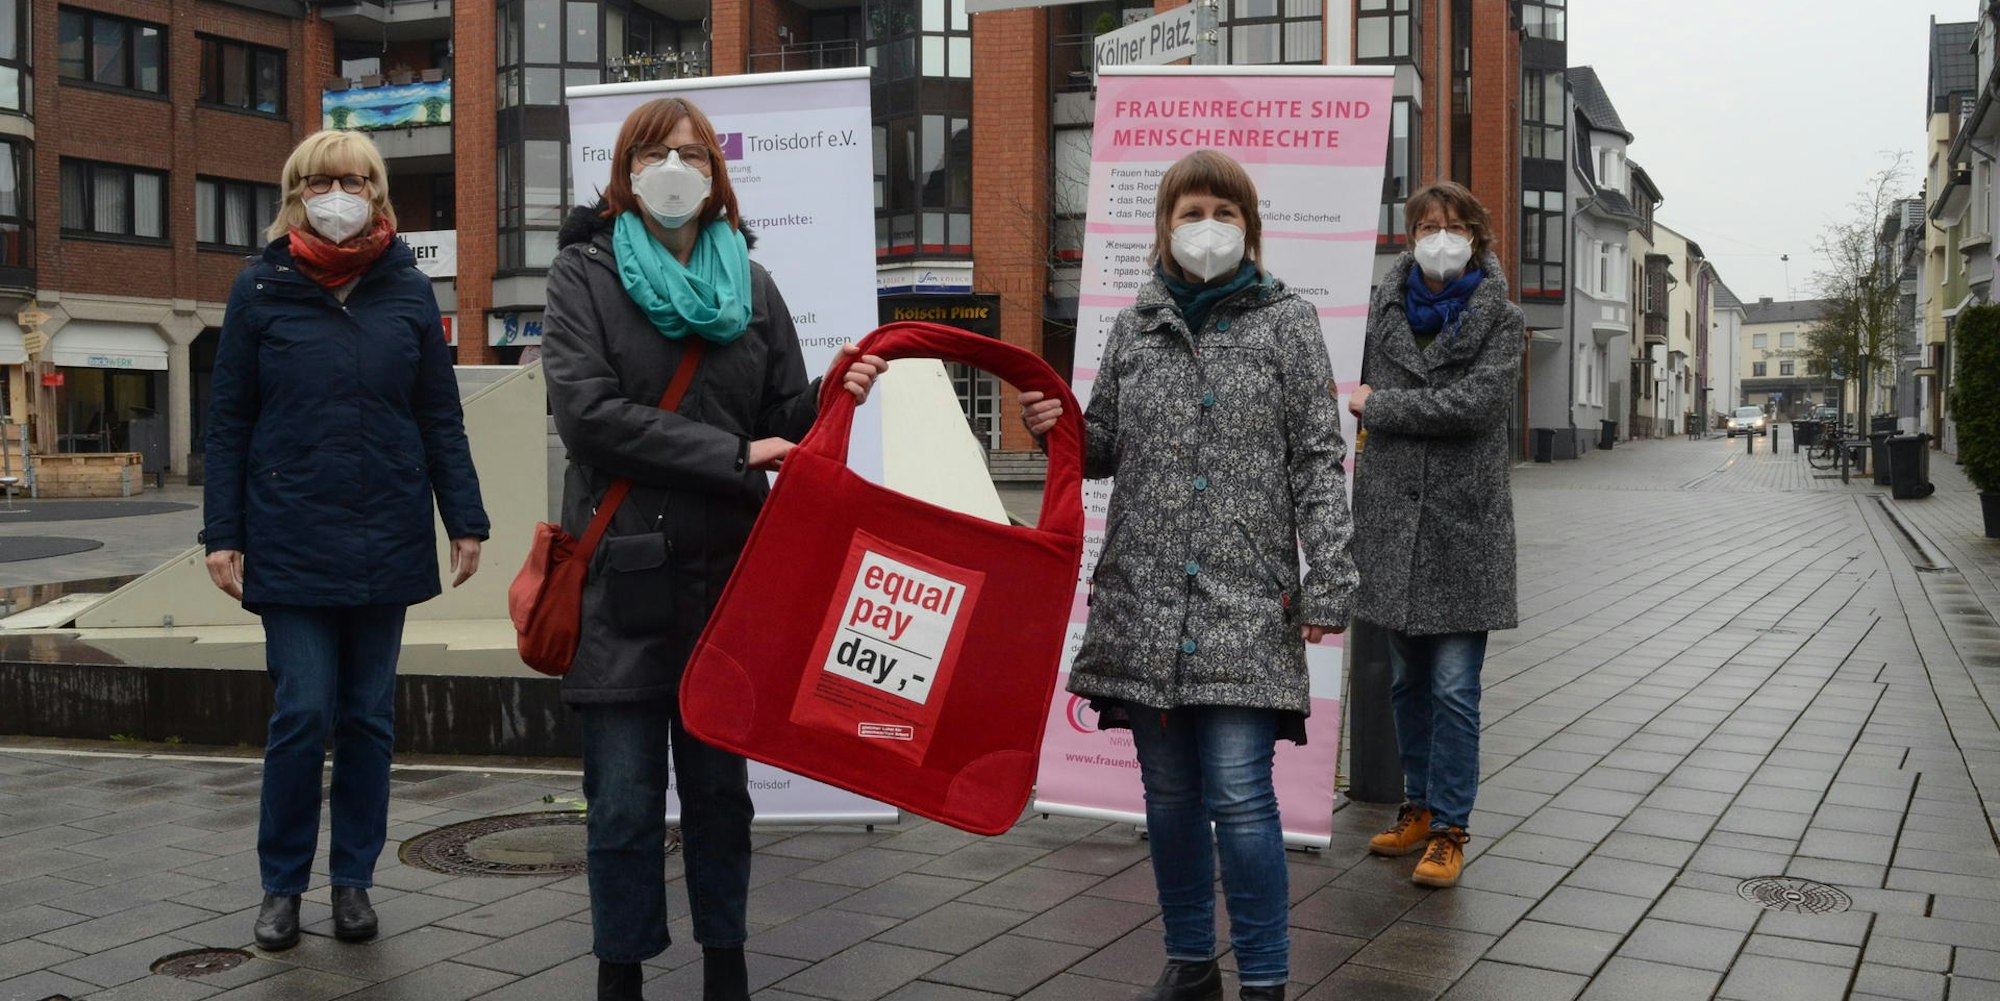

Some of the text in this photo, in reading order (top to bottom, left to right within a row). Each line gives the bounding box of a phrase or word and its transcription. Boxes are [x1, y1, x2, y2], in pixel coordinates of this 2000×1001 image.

[1096, 18, 1191, 66] Kölner Platz
[1115, 100, 1371, 119] FRAUENRECHTE SIND
[747, 131, 823, 153] Troisdorf
[828, 130, 857, 147] e.V.
[1113, 129, 1340, 148] MENSCHENRECHTE
[1111, 168, 1142, 177] Frauen
[1118, 182, 1135, 191] das
[1117, 196, 1133, 205] das
[745, 214, 813, 229] erpunkte:
[1116, 209, 1132, 218] das
[1293, 213, 1341, 223] Sicherheit
[1106, 241, 1147, 250] Женщины
[1115, 255, 1141, 264] право
[1114, 267, 1140, 277] право
[1113, 281, 1138, 290] право
[1093, 491, 1107, 500] the
[1092, 505, 1106, 513] the
[864, 565, 956, 616] equal
[849, 597, 913, 640] pay
[836, 638, 898, 684] day
[1066, 752, 1141, 768] www.frauenb
[749, 779, 791, 790] Troisdorf
